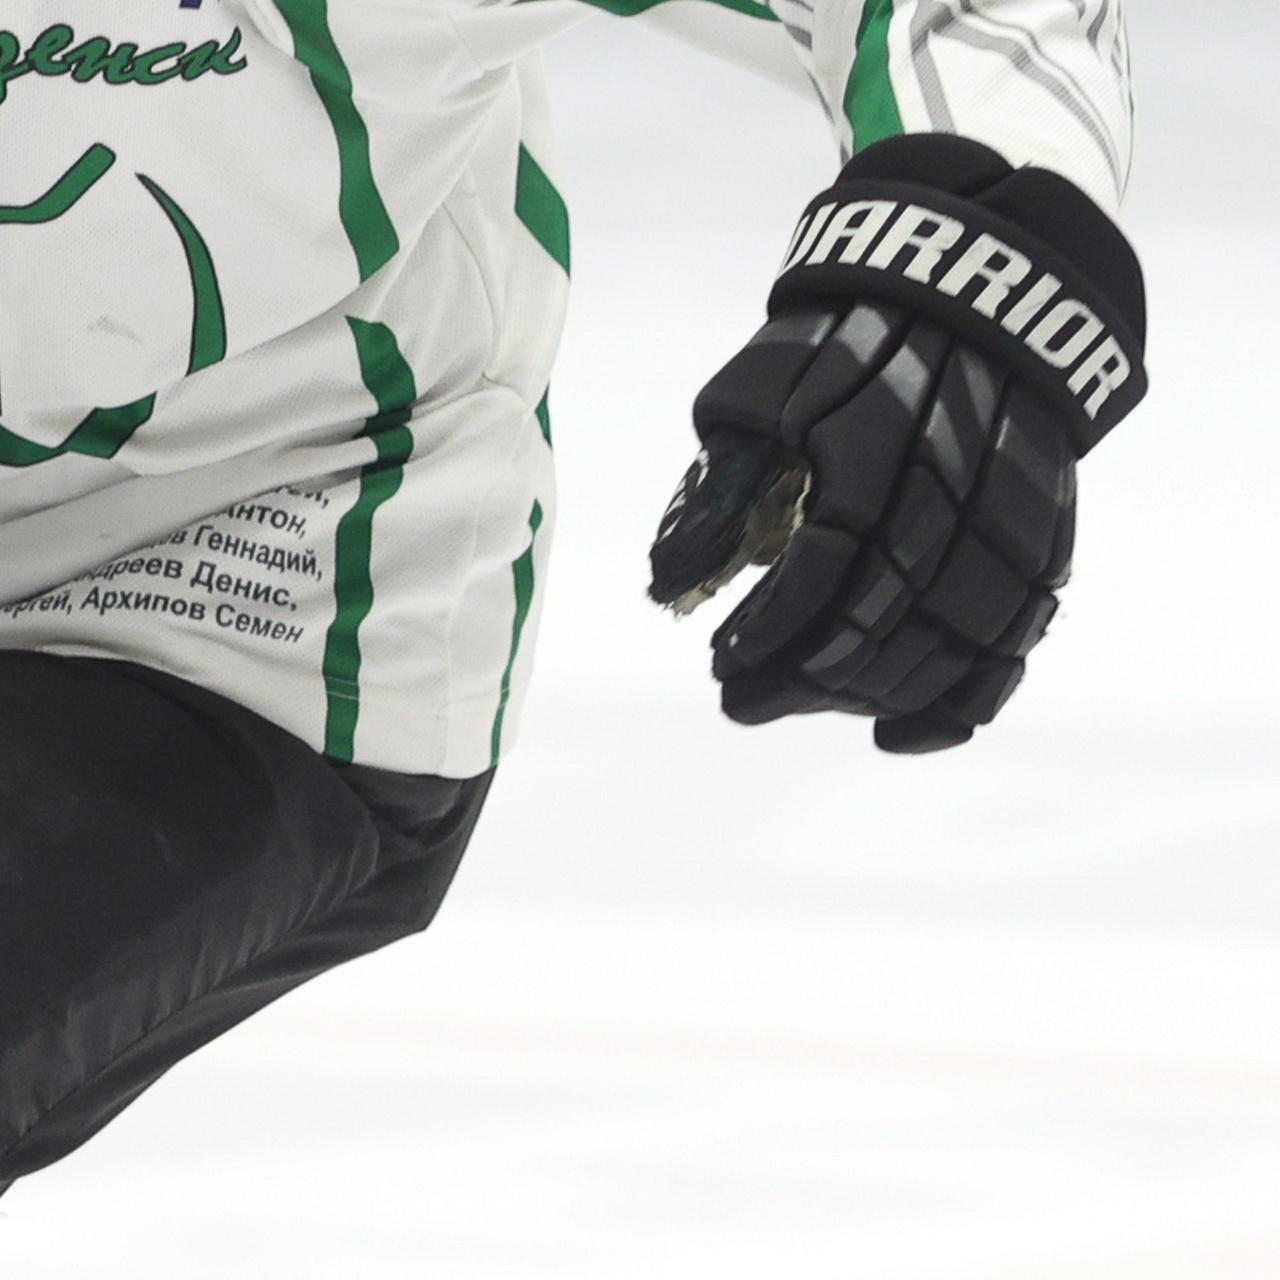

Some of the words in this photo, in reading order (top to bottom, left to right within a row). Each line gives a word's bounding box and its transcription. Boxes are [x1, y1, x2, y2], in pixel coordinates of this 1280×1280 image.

[193, 524, 323, 582] Геннадий,
[190, 560, 297, 611] Денис,
[80, 586, 206, 621] Архипов
[216, 603, 305, 643] Семен
